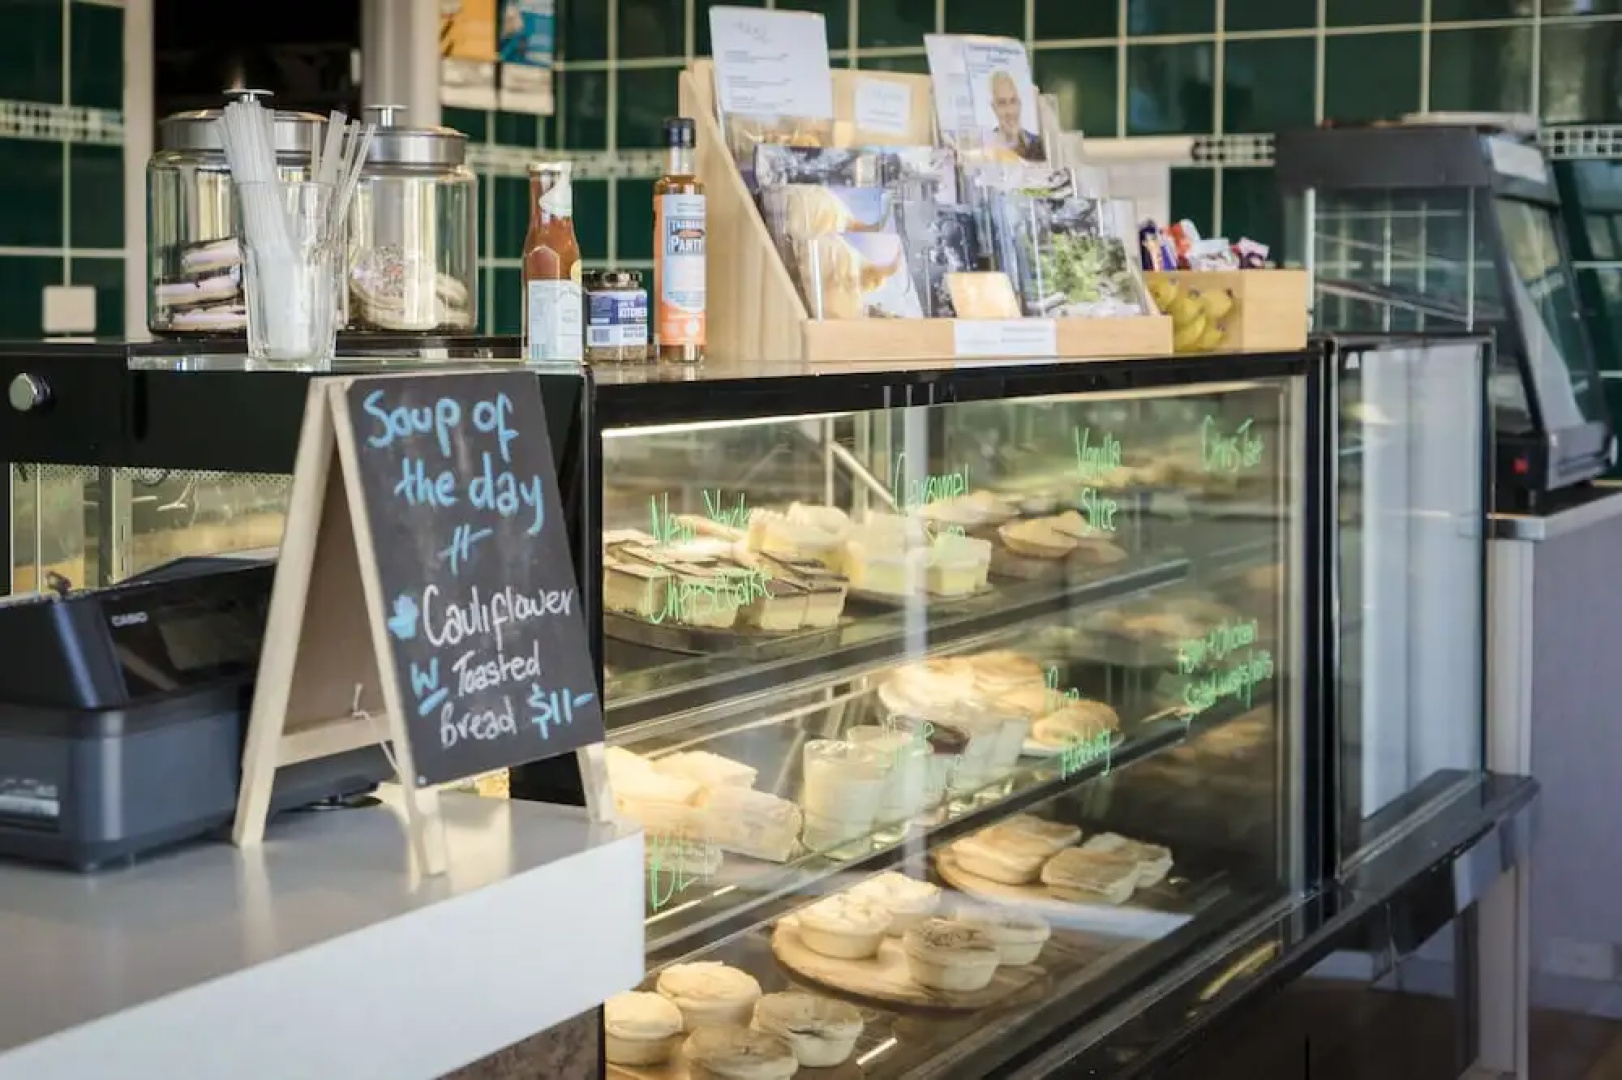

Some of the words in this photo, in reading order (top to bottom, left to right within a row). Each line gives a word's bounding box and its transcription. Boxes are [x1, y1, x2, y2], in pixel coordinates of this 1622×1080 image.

[362, 389, 461, 457] Soup
[472, 391, 520, 464] of
[394, 456, 460, 512] the
[468, 450, 546, 536] day
[111, 611, 148, 628] CASIO
[422, 583, 573, 651] Cauliflower
[452, 639, 541, 697] Toasted
